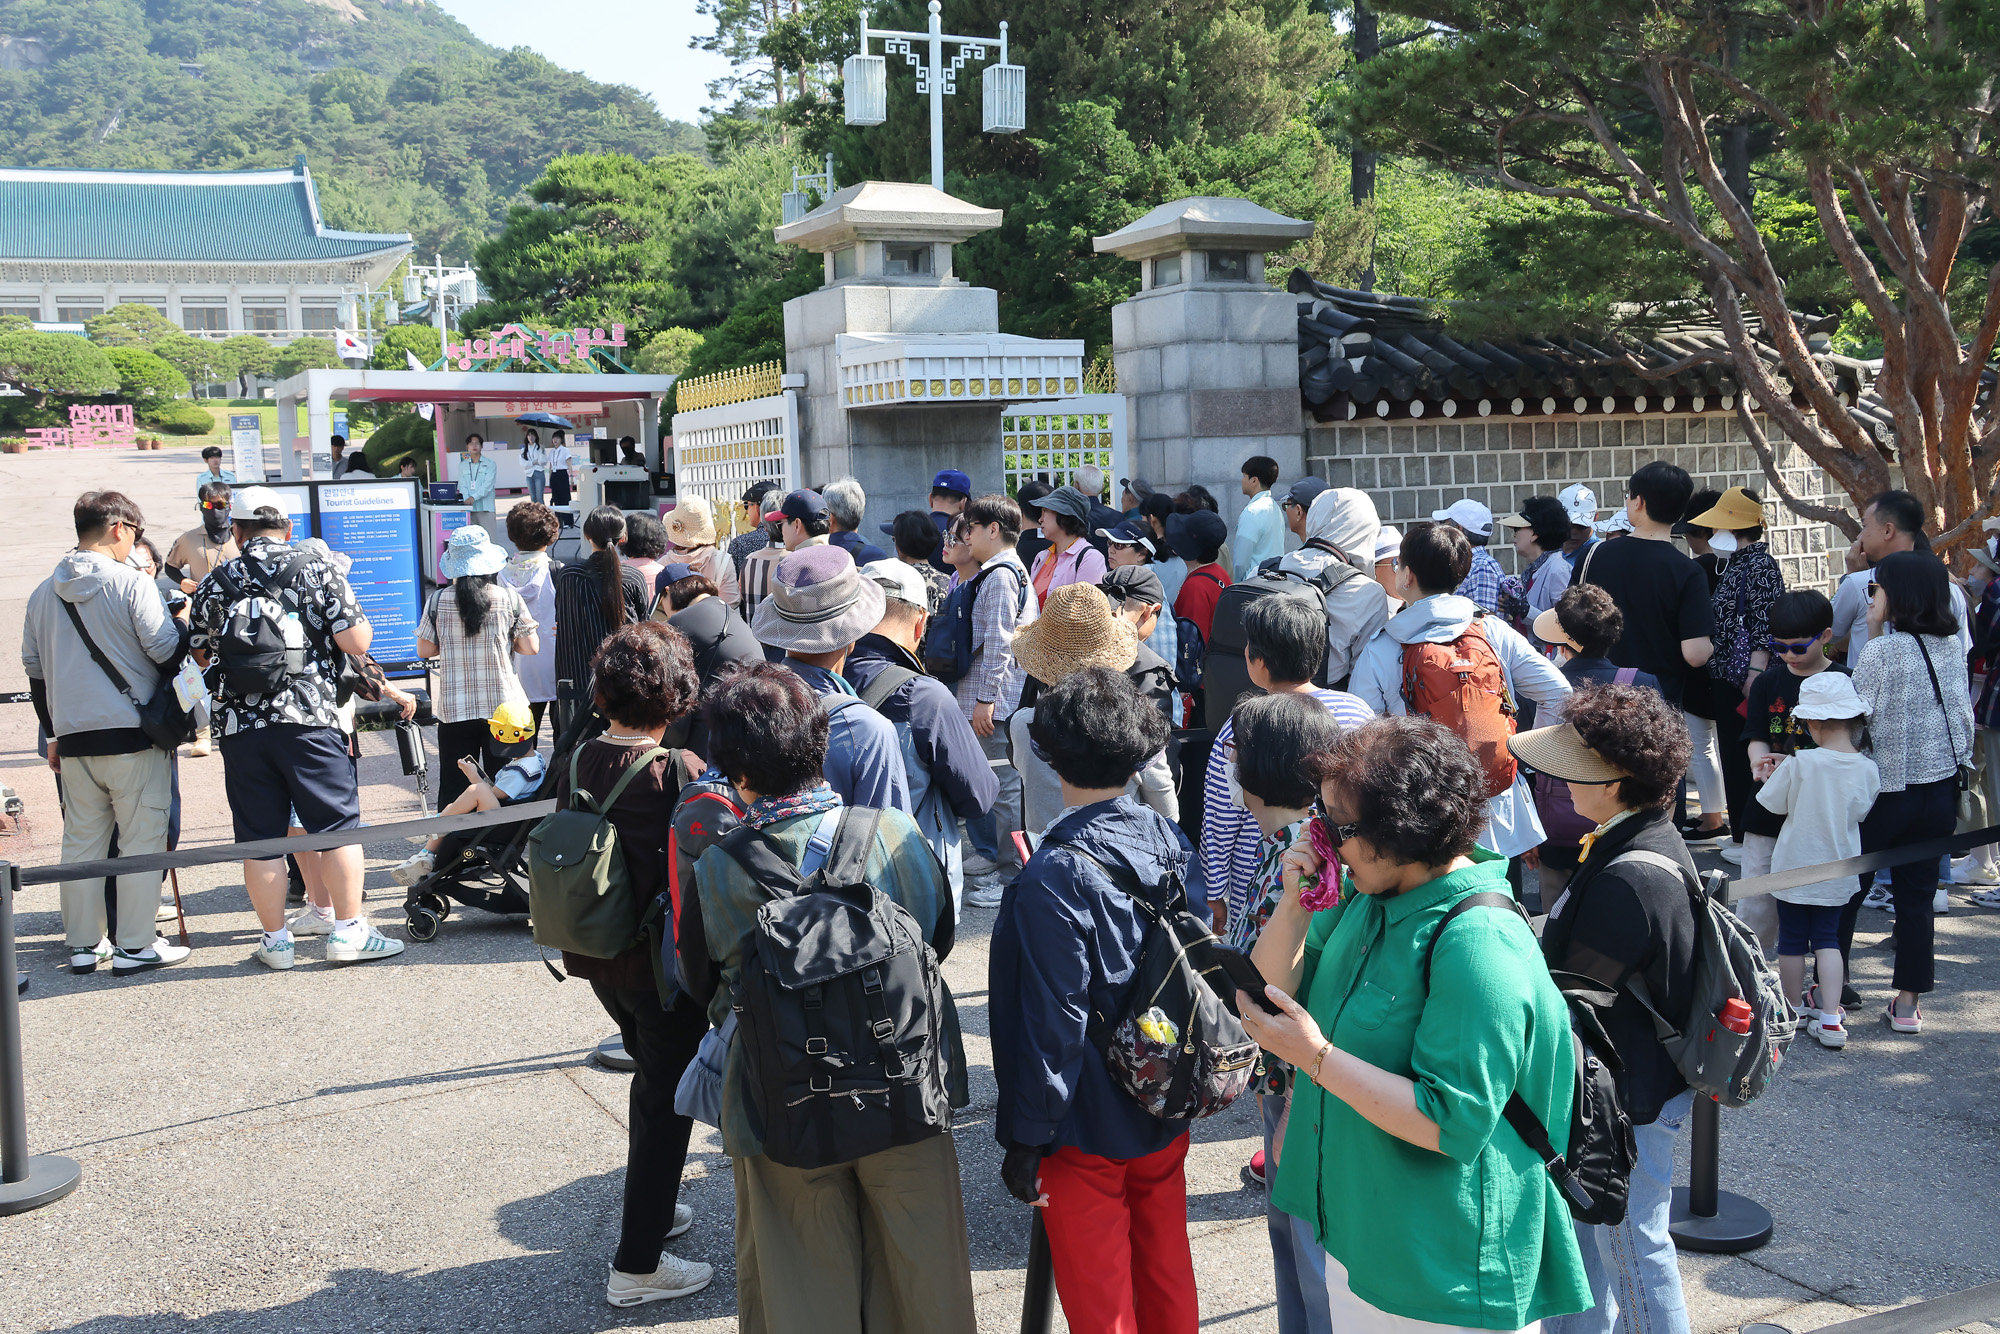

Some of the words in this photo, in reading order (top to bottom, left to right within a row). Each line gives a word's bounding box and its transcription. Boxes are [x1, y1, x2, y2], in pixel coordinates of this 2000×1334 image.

[534, 329, 571, 365] 국민
[573, 323, 628, 359] 품으로
[68, 404, 134, 431] 청와대
[25, 427, 72, 450] 국민
[324, 488, 355, 498] 관람안내
[325, 498, 352, 507] Tourist
[353, 497, 394, 506] Guidelines
